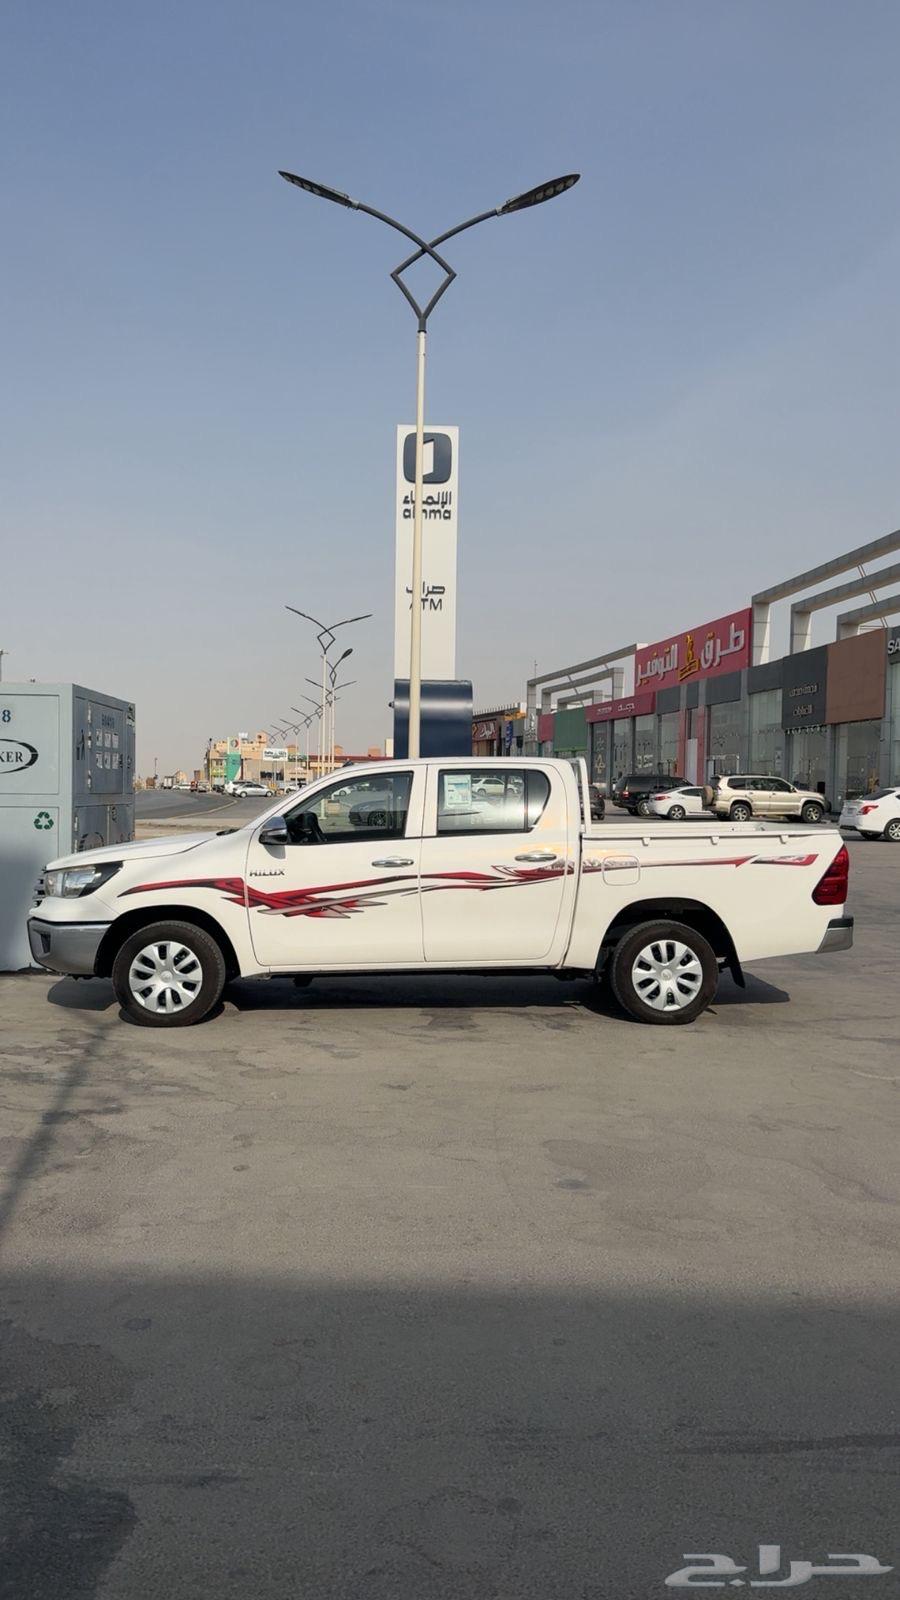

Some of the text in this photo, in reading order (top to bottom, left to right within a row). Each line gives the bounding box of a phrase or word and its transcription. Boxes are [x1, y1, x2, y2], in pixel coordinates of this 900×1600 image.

[403, 505, 451, 520] alnma
[409, 598, 442, 611] TM
[636, 622, 745, 687] طرق التوفير
[249, 868, 286, 877] HILUX
